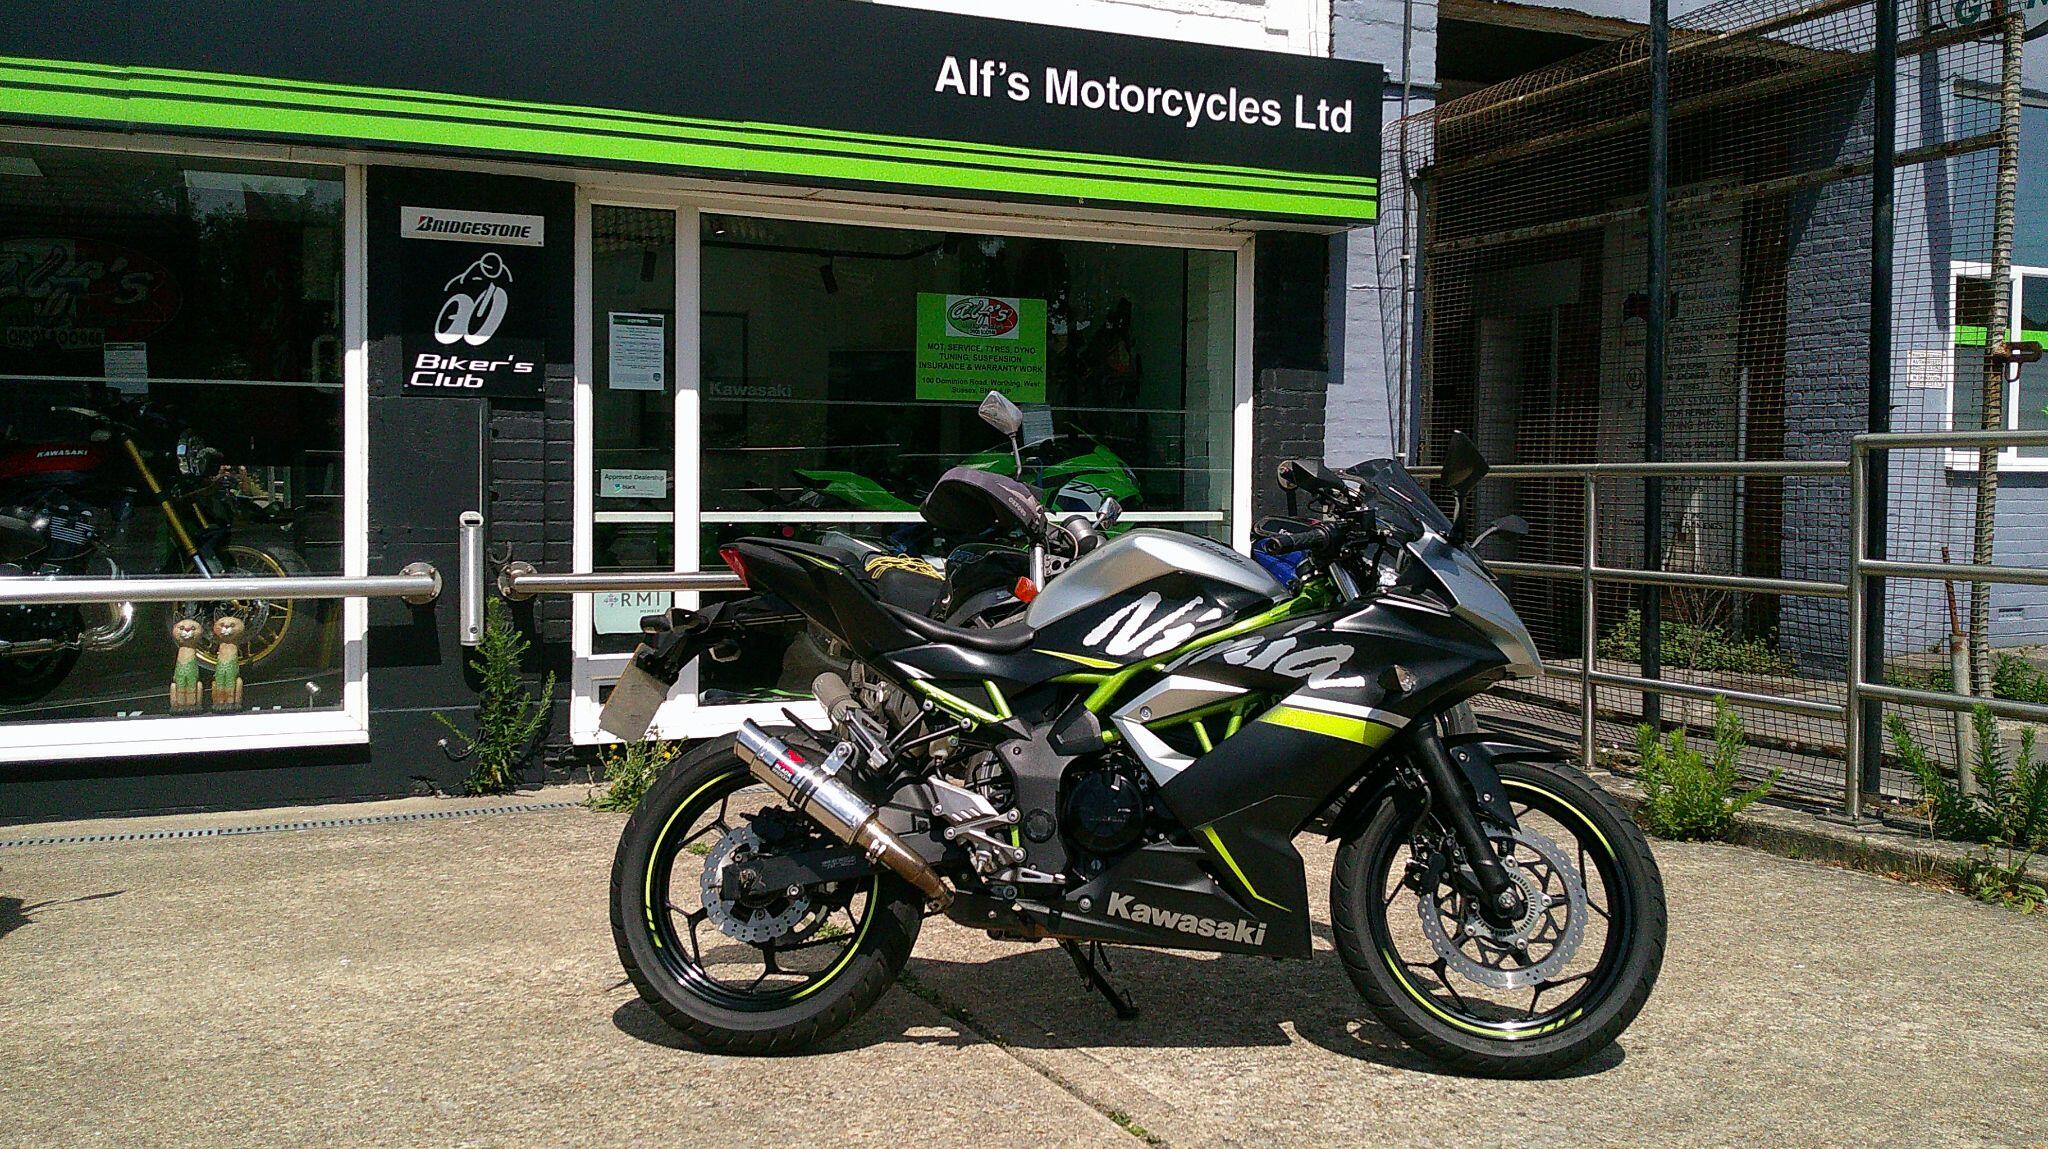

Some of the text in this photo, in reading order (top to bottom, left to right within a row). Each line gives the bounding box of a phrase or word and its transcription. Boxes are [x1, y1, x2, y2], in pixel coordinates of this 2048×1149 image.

[934, 55, 1352, 133] Alf’s Motorcycles Ltd
[415, 216, 531, 238] BRIDGESTONE
[1014, 346, 1036, 354] DYNO
[415, 353, 535, 373] Biker's
[919, 362, 965, 371] INSURANCE
[974, 364, 1017, 373] WARRANTY
[1019, 365, 1043, 374] WORK
[410, 371, 484, 388] Club
[935, 377, 968, 385] Dominion
[709, 381, 791, 398] Kawasaki
[37, 450, 88, 458] KAWASAKI
[621, 592, 660, 607] RMI
[1082, 591, 1366, 690] Ninja
[1107, 891, 1267, 946] Kawasaki
